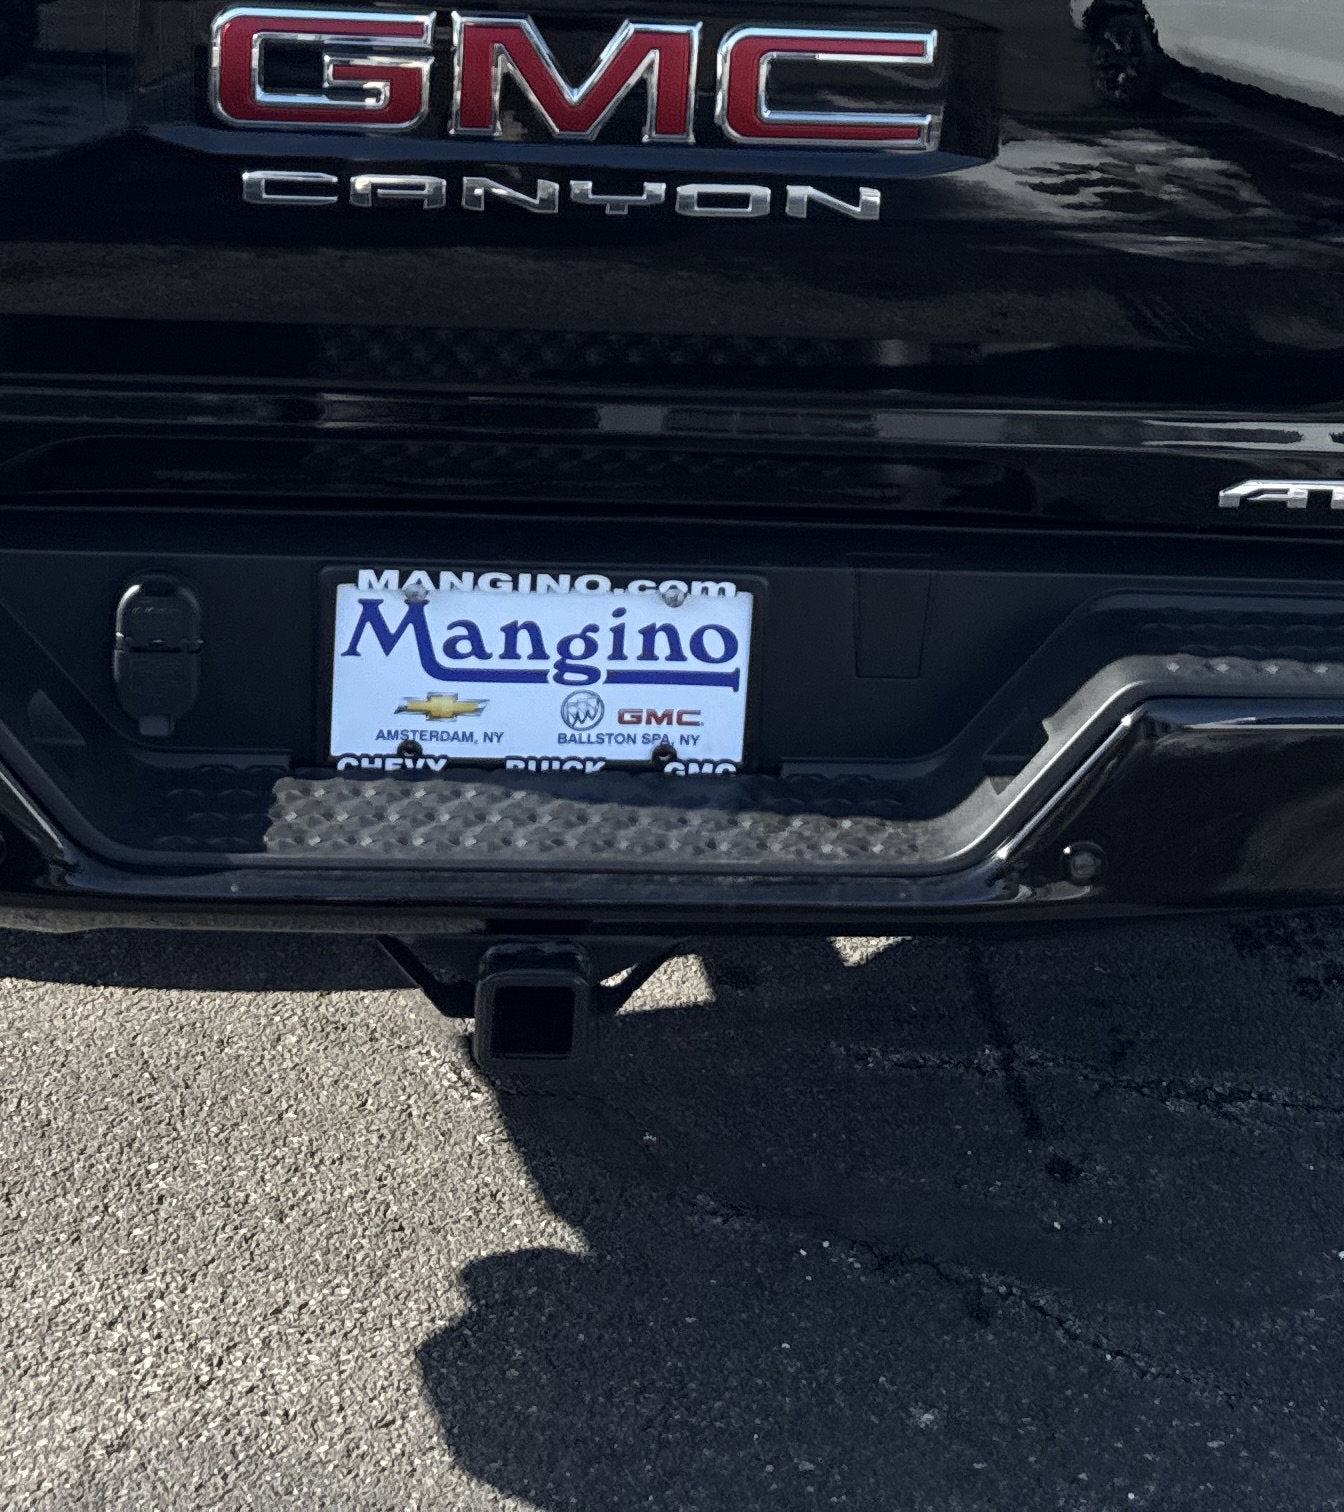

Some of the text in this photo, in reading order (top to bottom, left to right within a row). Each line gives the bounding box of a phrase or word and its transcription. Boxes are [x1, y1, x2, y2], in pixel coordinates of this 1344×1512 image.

[210, 6, 943, 152] GMC
[242, 169, 881, 221] CANYON
[358, 568, 737, 598] MANGINO.com
[340, 596, 740, 692] Mangino
[617, 707, 702, 727] GMC
[375, 728, 505, 745] AMSTERDAM, NY
[557, 732, 638, 745] BALLSTON
[679, 734, 701, 747] NY
